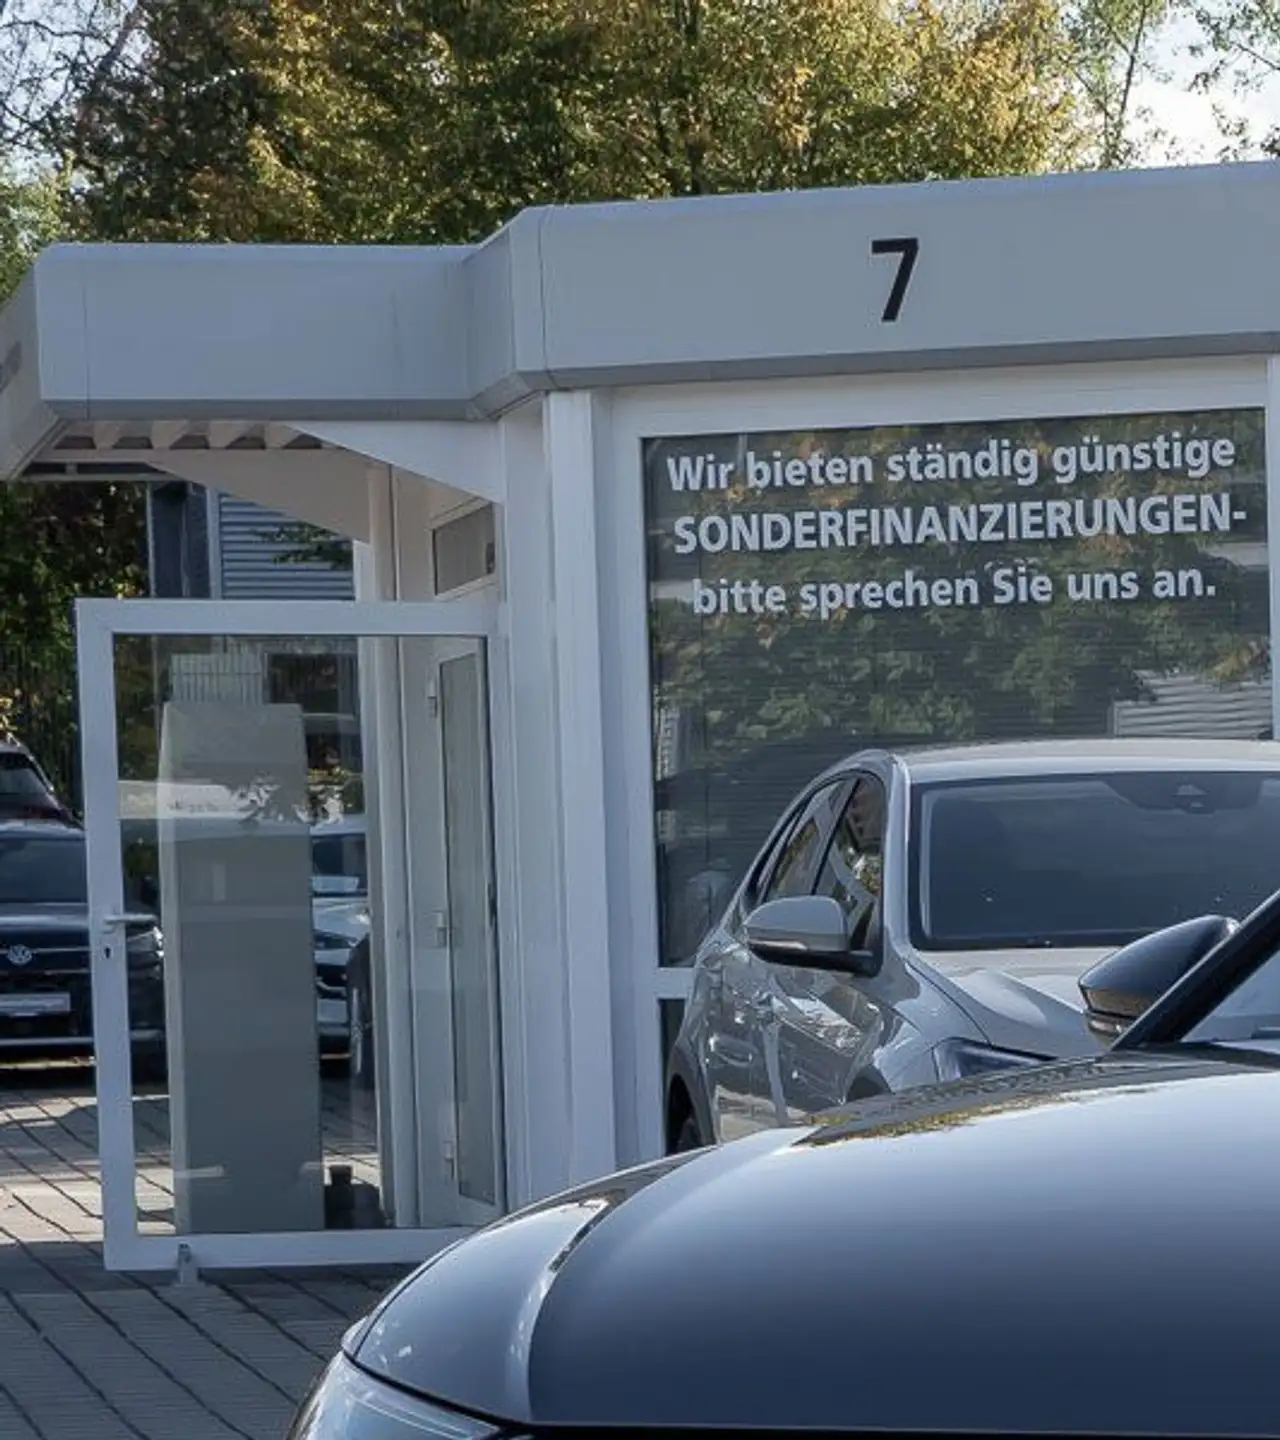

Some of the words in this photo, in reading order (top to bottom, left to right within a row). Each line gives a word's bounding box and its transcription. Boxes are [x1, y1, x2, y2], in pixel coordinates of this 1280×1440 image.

[871, 237, 919, 322] 7
[666, 453, 733, 491] Wir
[747, 450, 874, 489] bieten
[887, 438, 1039, 486] ständig
[1052, 431, 1236, 485] günstige
[673, 492, 1248, 555] SONDERFINANZIERUNGEN-
[693, 577, 787, 614] bitte
[800, 569, 979, 620] sprechen
[993, 565, 1053, 604] Sie
[1067, 570, 1140, 600] uns
[1153, 567, 1216, 598] an.
